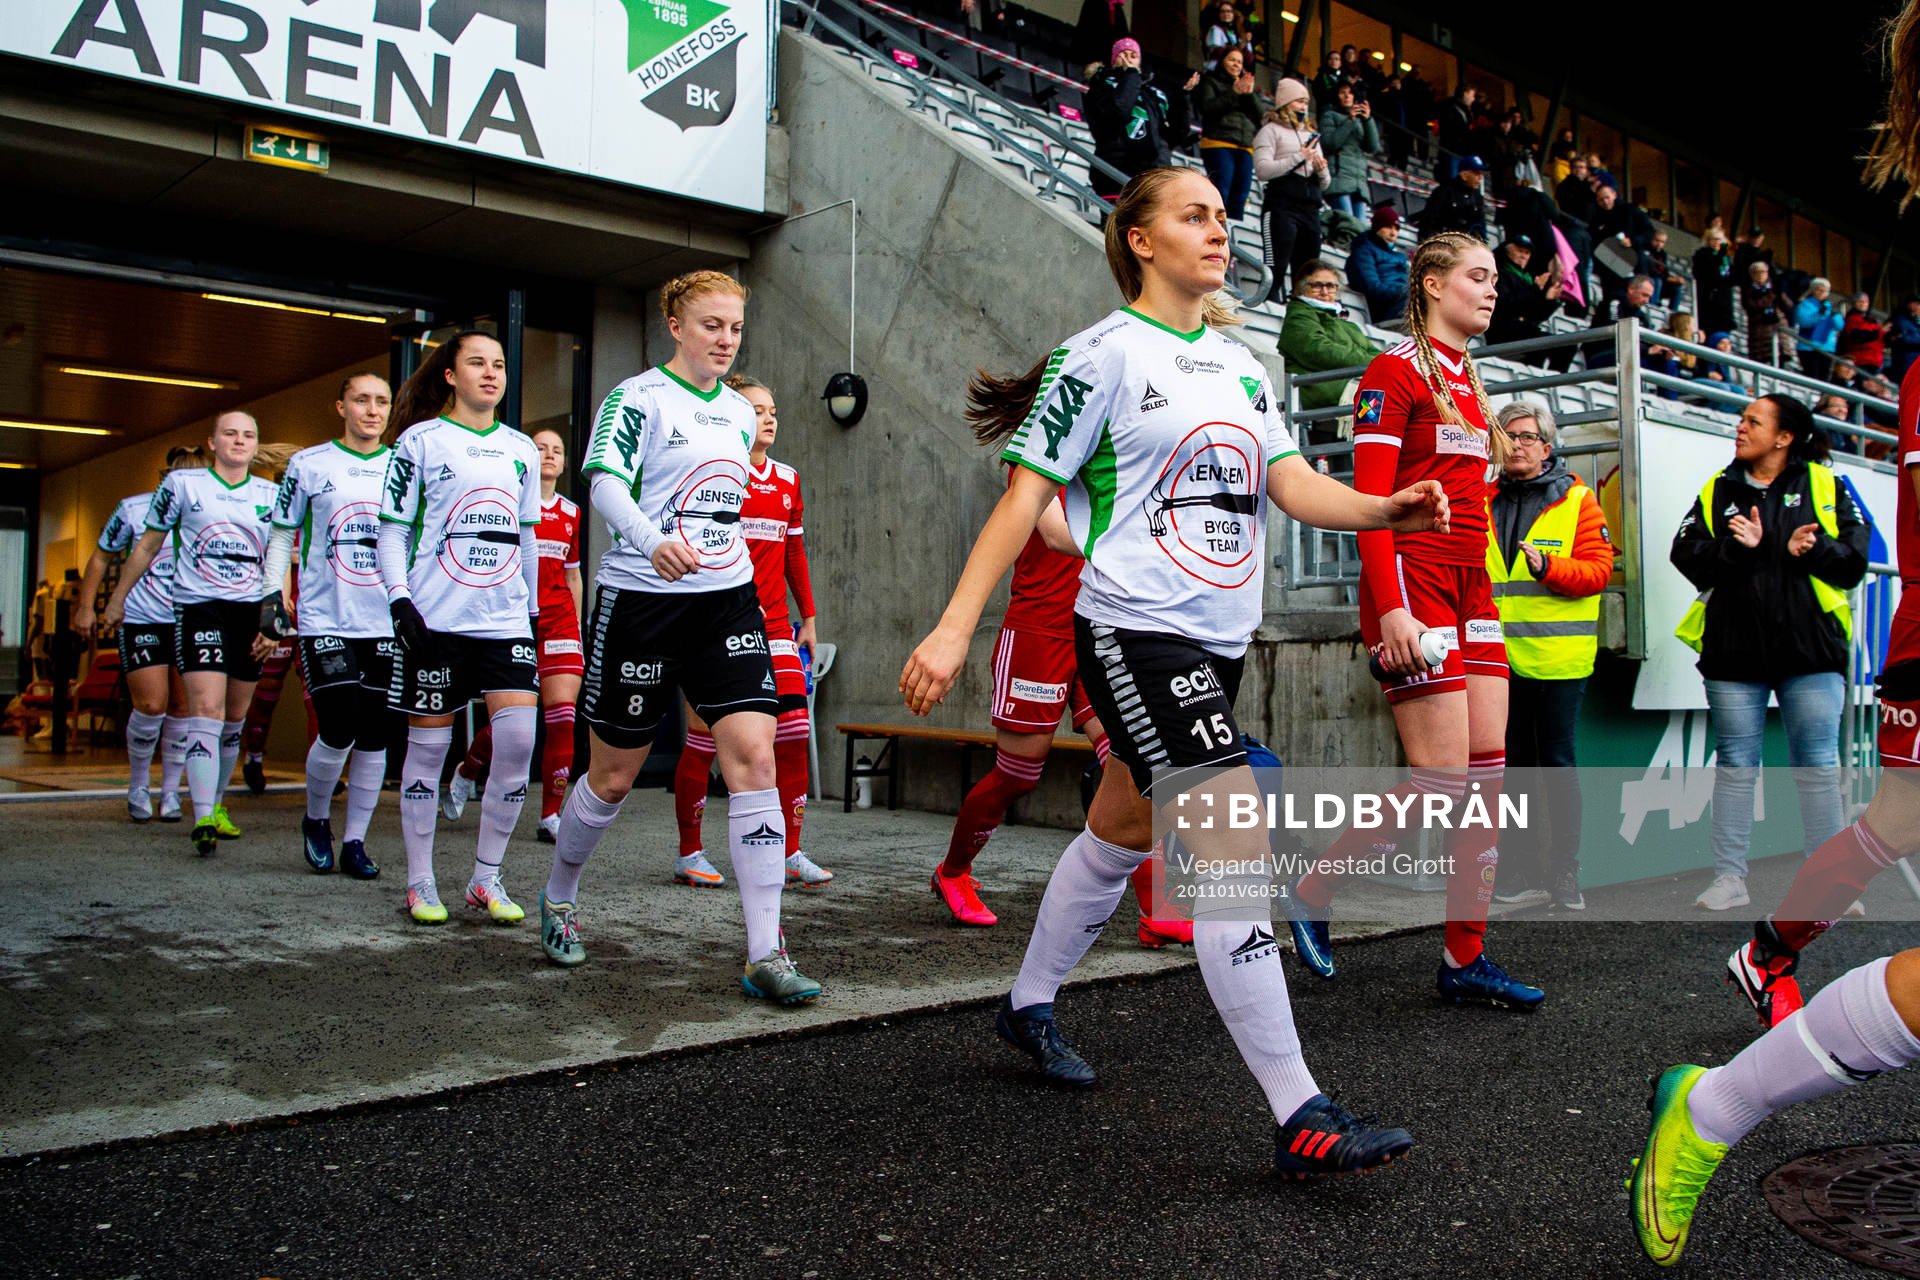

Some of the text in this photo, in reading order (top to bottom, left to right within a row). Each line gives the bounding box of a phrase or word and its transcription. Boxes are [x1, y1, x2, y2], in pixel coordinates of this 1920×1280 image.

[643, 0, 687, 13] BRUAR
[652, 6, 689, 28] 1895
[638, 18, 737, 90] HØNEFOSS
[50, 0, 545, 159] ARENA
[686, 83, 721, 113] BK
[1140, 399, 1169, 413] SELECT
[1038, 374, 1094, 463] AKA
[612, 405, 647, 472] AKA
[387, 456, 416, 514] AKA
[460, 513, 511, 526] JENSEN
[1204, 520, 1241, 535] BYGG
[343, 523, 380, 535] JENSE
[207, 540, 248, 551] JENSEN
[469, 546, 498, 557] BYGG
[1206, 538, 1239, 553] TEAM
[155, 562, 174, 571] JEN
[468, 557, 497, 567] TEAM
[725, 630, 767, 651] ecit
[131, 649, 152, 664] 11
[198, 648, 223, 663] 22
[416, 667, 452, 684] ecit
[620, 659, 664, 680] ecit
[1014, 681, 1057, 695] SpareBank
[1170, 662, 1221, 698] ecit
[414, 690, 443, 711] 28
[627, 694, 644, 716] 8
[1005, 702, 1016, 714] 17
[1179, 692, 1216, 708] ECONOMICS
[1190, 713, 1234, 750] 15
[1232, 945, 1279, 967] SELEC
